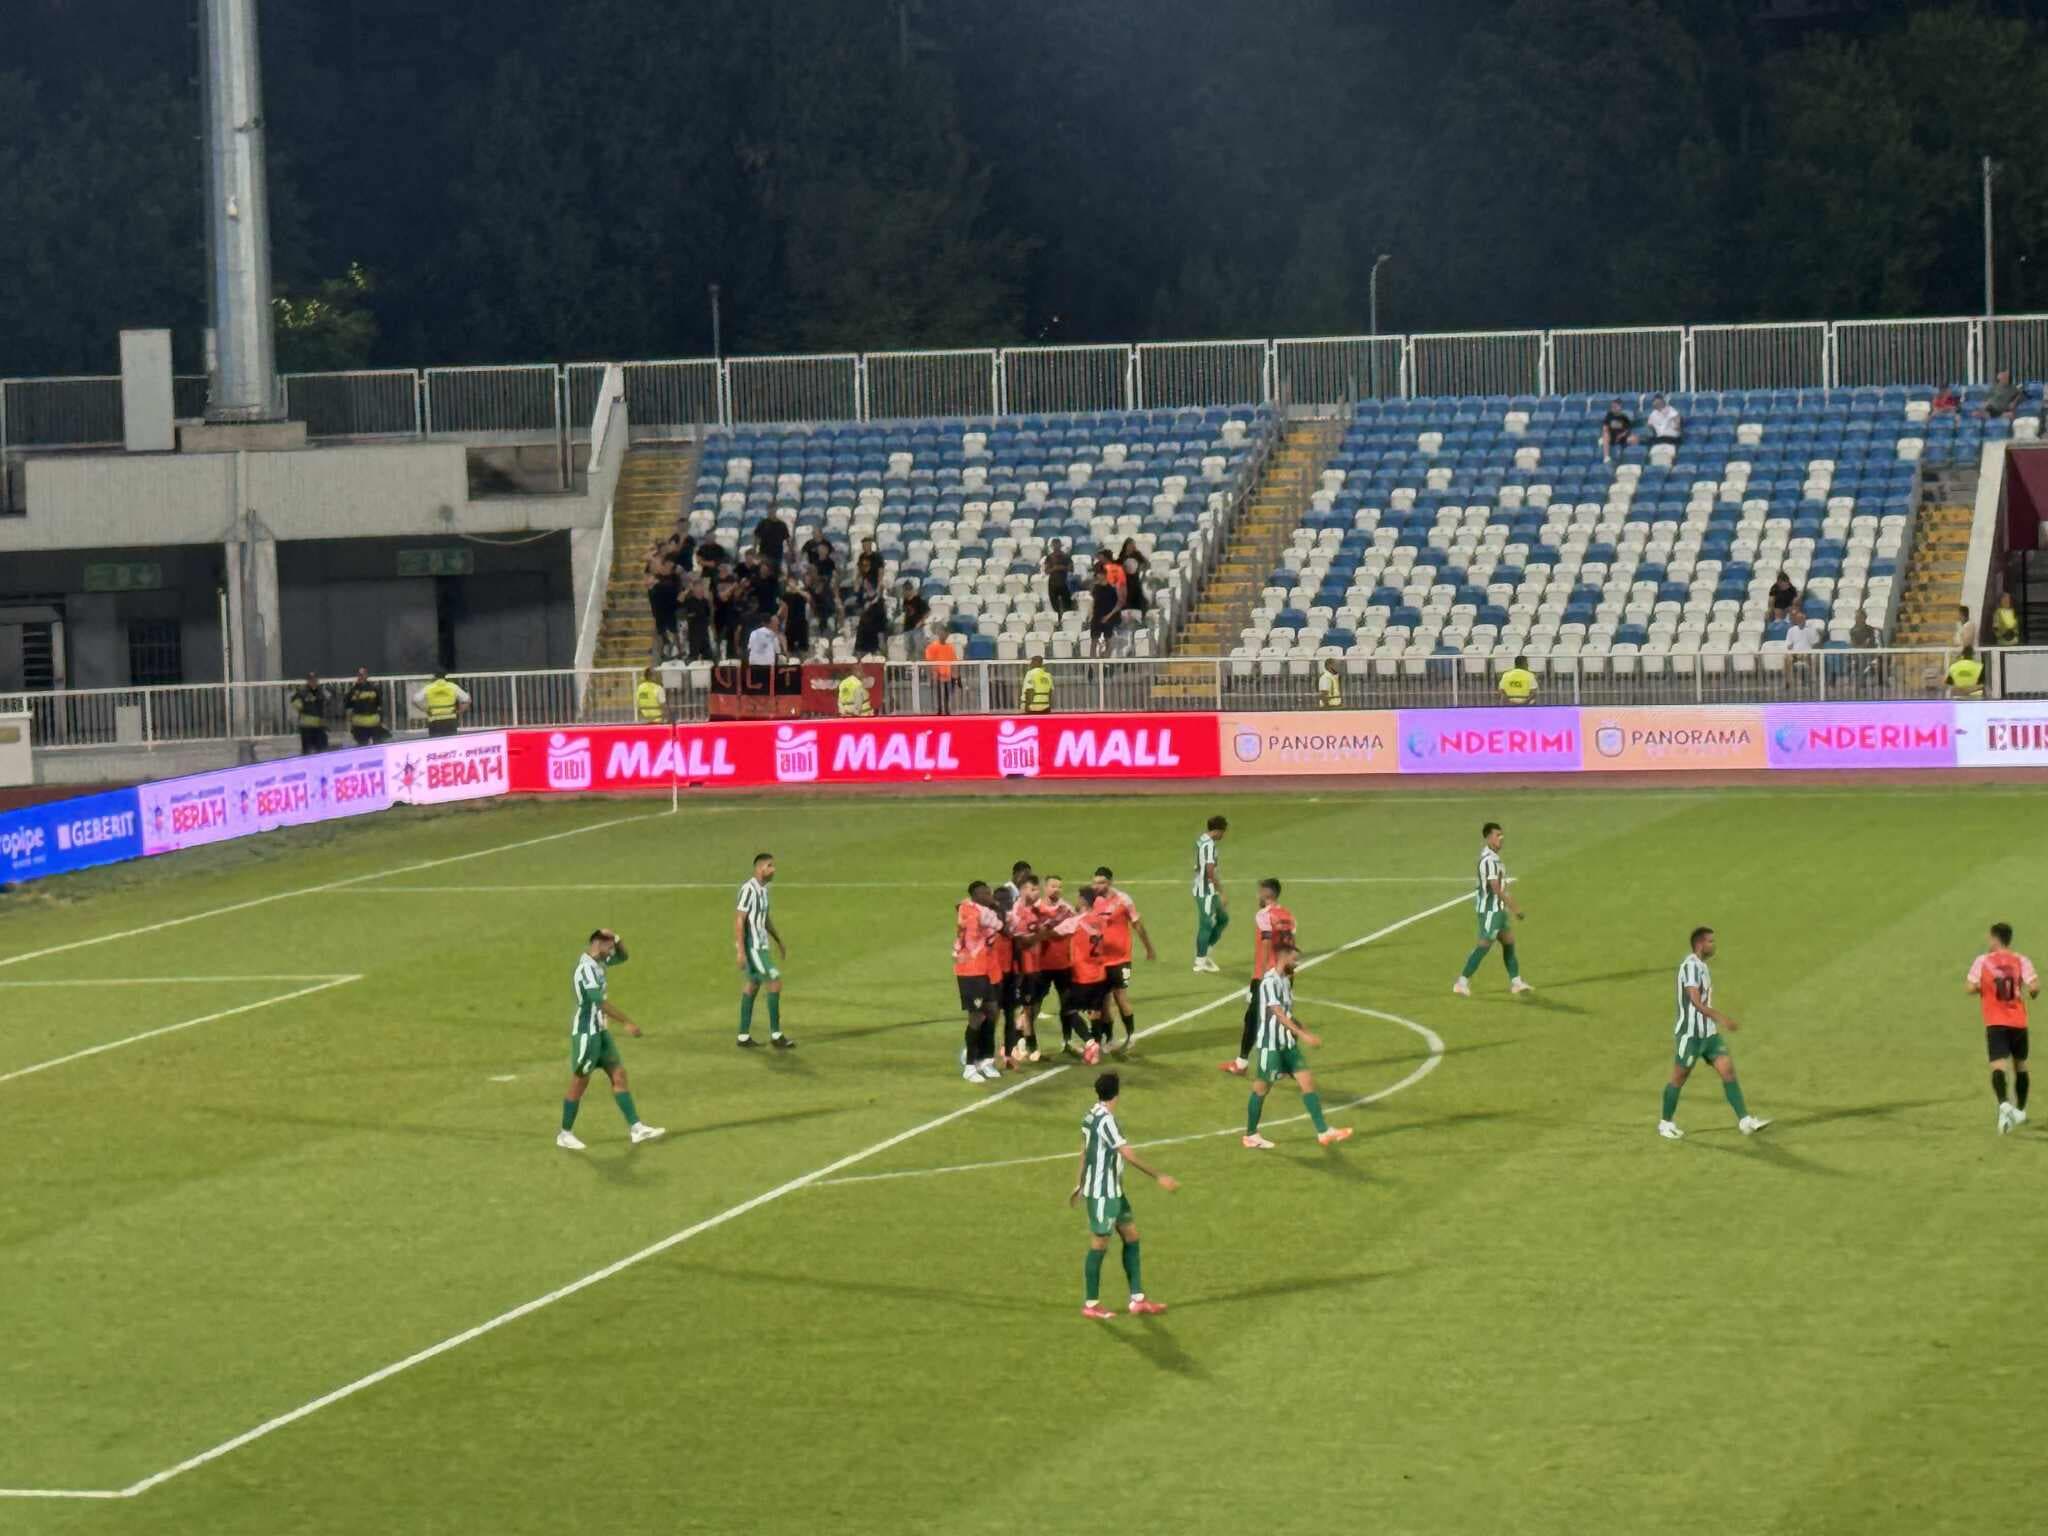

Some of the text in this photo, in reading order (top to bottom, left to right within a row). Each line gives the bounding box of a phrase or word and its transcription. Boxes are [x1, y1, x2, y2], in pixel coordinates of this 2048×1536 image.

[1054, 729, 1180, 768] MALL
[1269, 735, 1384, 751] PANORAMA
[1439, 728, 1573, 754] NDERIMI
[1632, 729, 1751, 745] PANORAMA
[1809, 724, 1949, 750] NDERIMI
[606, 738, 735, 779] MALL
[833, 732, 959, 772] MALL
[72, 810, 134, 847] GEBERIT
[1994, 976, 2015, 1002] 10
